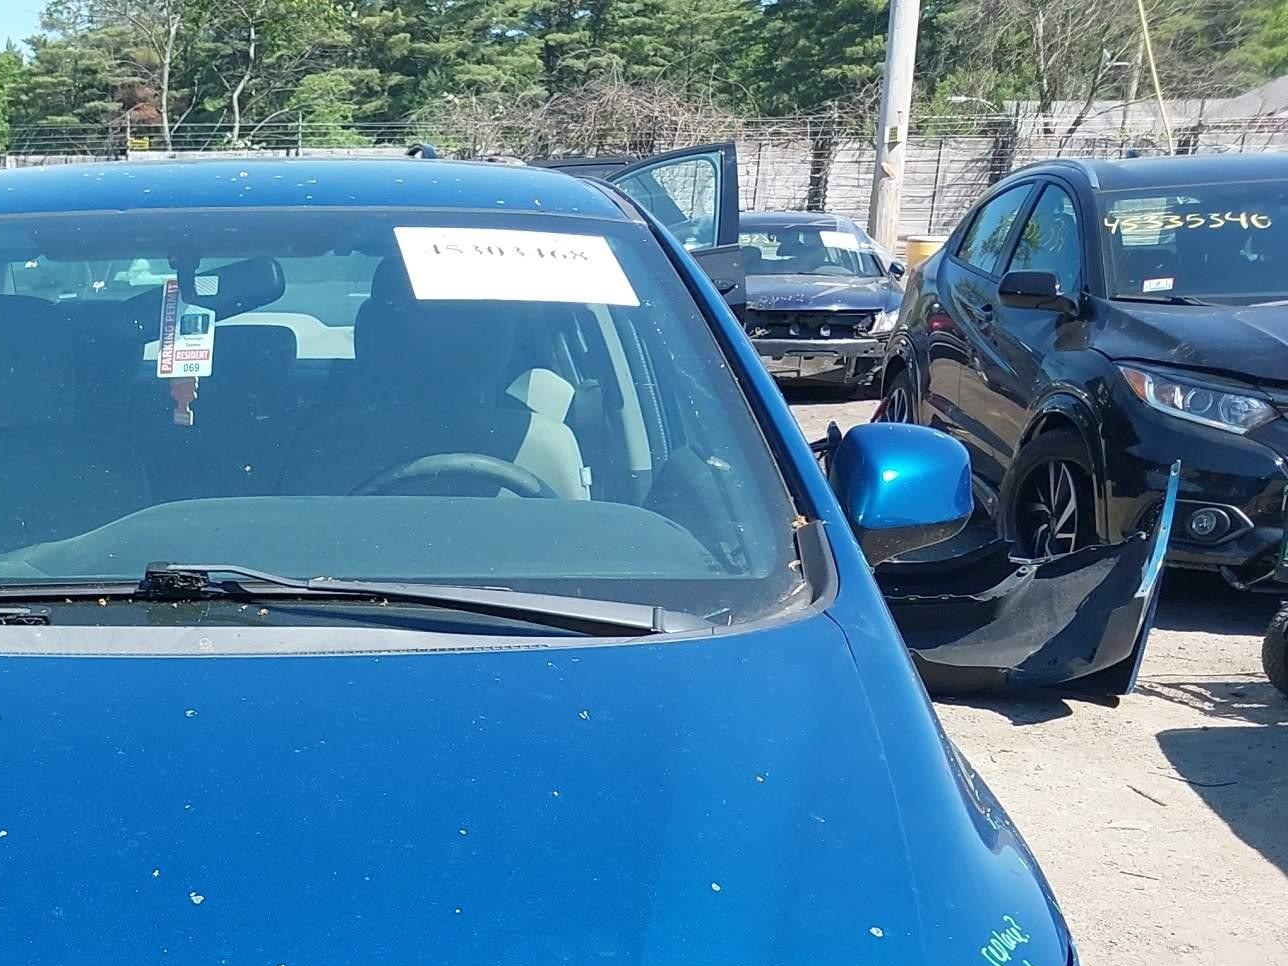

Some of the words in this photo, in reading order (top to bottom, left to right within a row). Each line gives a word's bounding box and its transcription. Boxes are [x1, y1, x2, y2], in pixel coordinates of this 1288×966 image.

[165, 282, 179, 322] PERMIT
[161, 325, 175, 371] PARKING
[176, 350, 209, 360] RESIDENT
[183, 364, 200, 372] 069
